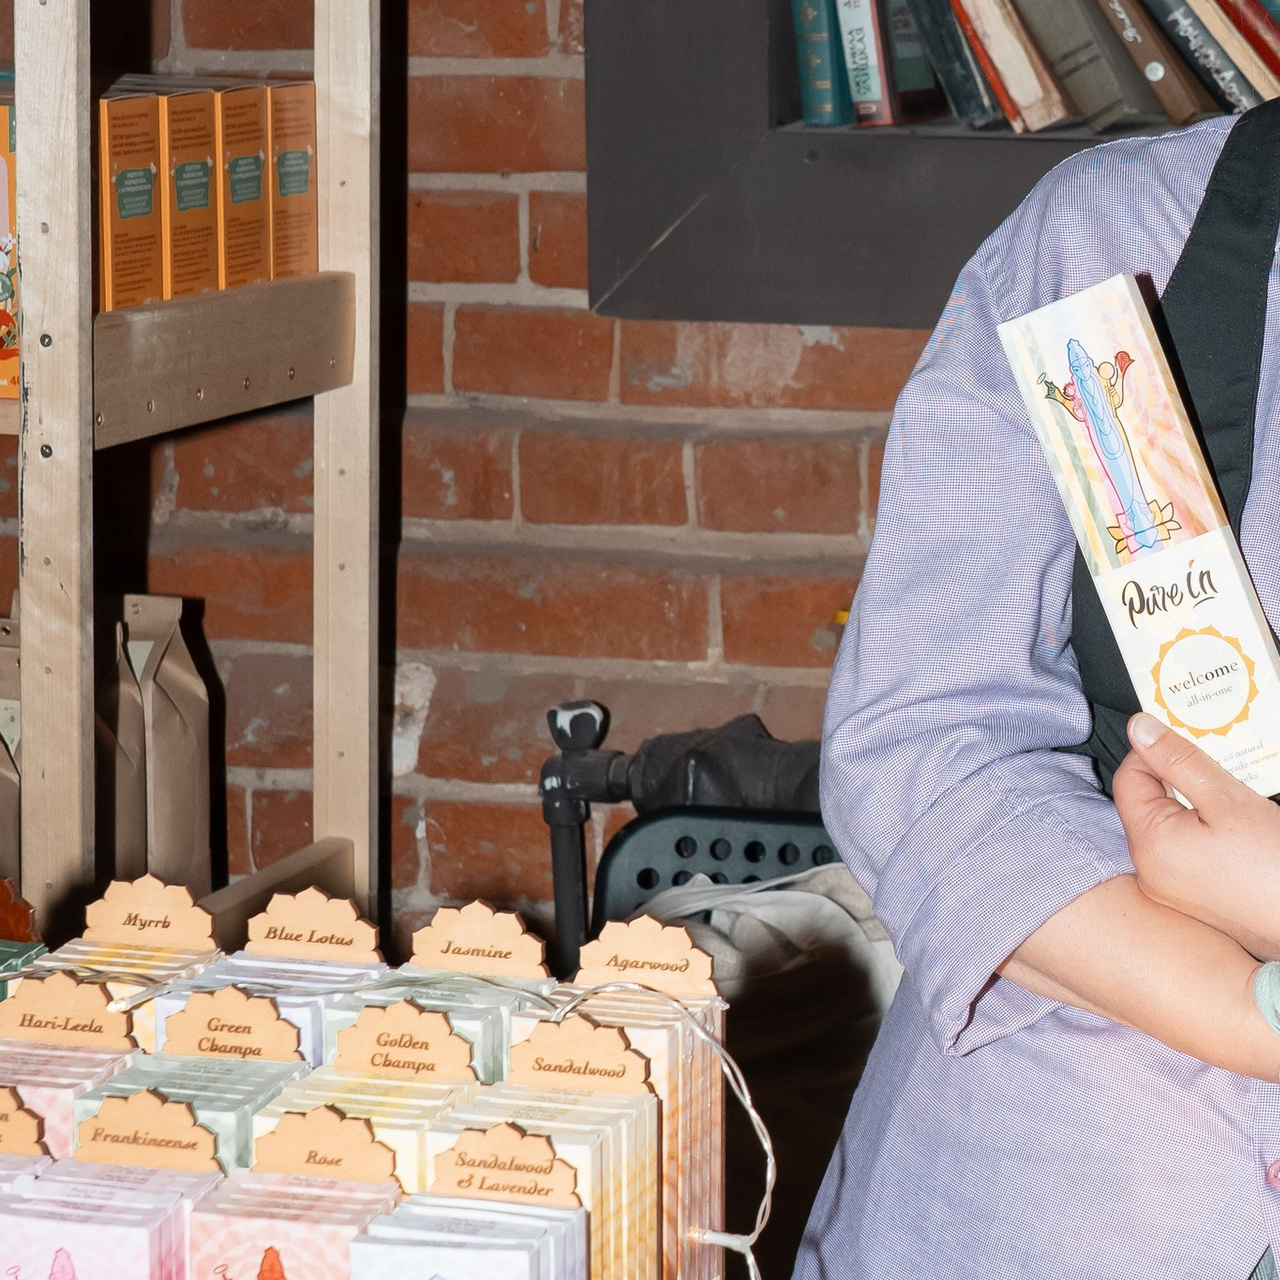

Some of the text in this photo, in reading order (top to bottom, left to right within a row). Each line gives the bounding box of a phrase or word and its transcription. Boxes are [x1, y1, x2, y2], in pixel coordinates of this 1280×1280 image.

[1121, 580, 1184, 630] Pure
[1168, 661, 1239, 695] welcome
[1186, 685, 1233, 708] all-in-one
[1235, 741, 1264, 758] natural
[1250, 751, 1279, 767] incense
[264, 926, 354, 946] Blue Lotus
[440, 940, 513, 960] Jasmine
[605, 953, 690, 974] Agarwood
[19, 1014, 104, 1034] Hari-Leela
[207, 1018, 252, 1034] Green
[376, 1032, 430, 1051] Golden
[532, 1057, 627, 1079] Sandalwood
[90, 1127, 199, 1151] Frankincense
[305, 1150, 344, 1167] Rose
[455, 1152, 554, 1175] Sandalwood
[477, 1176, 554, 1197] Lavender
